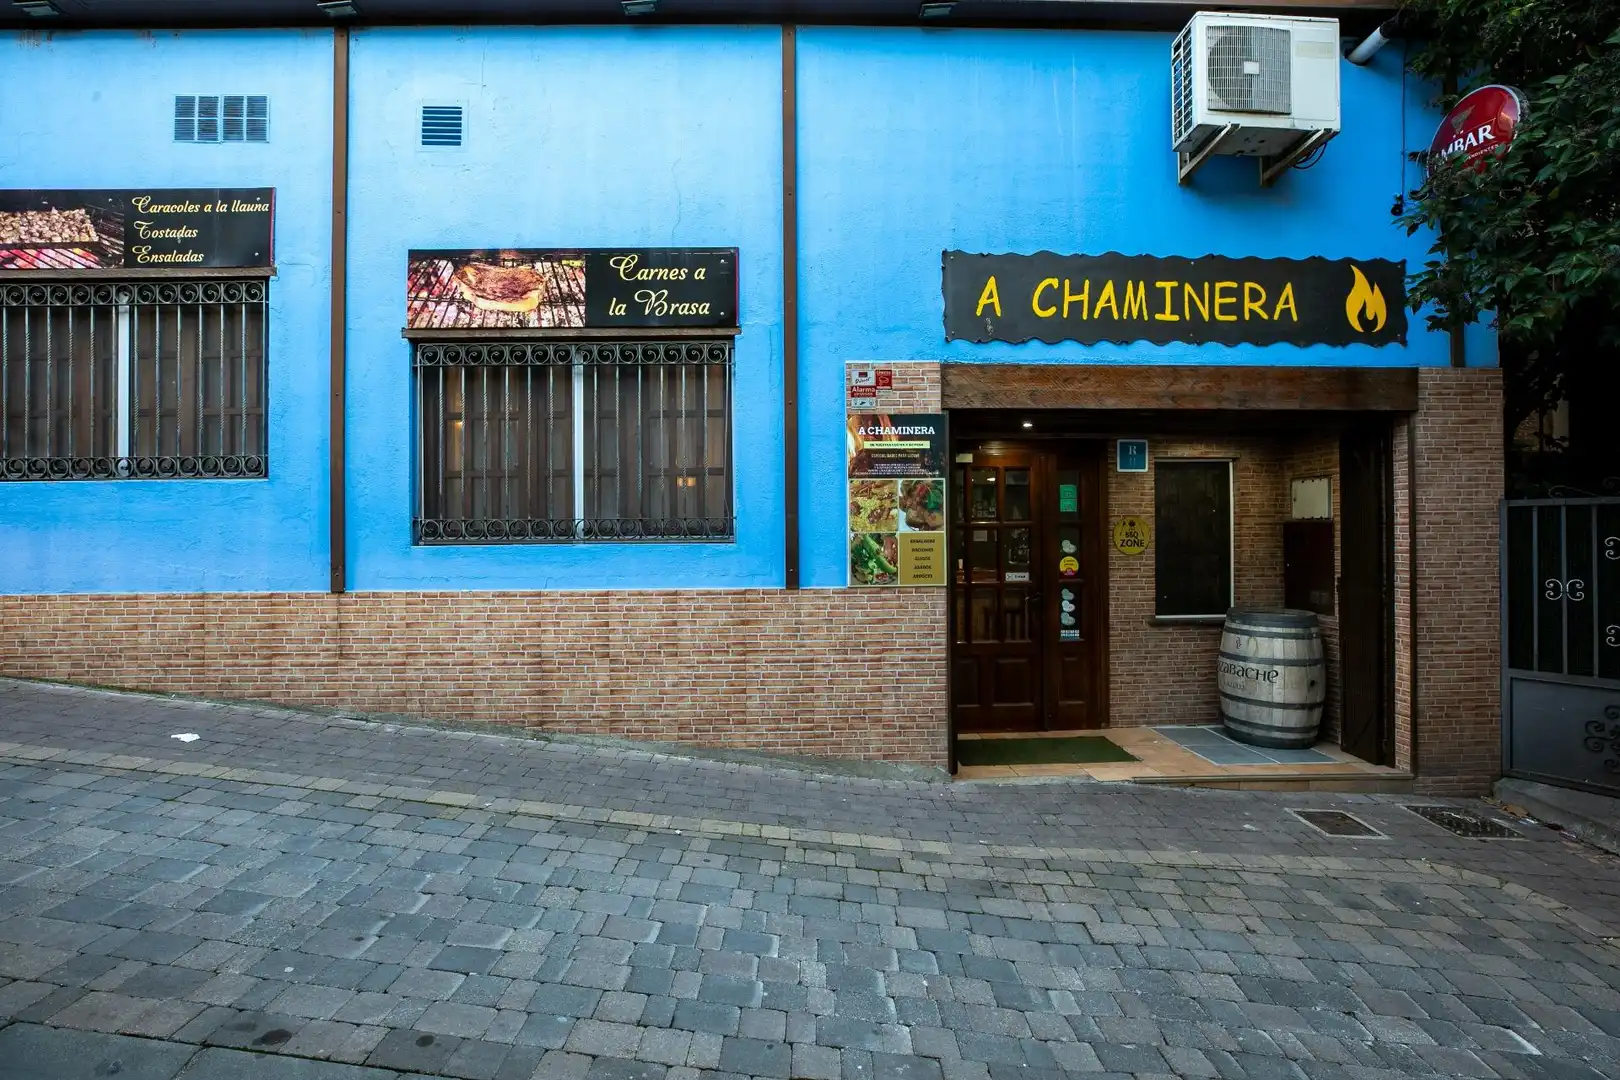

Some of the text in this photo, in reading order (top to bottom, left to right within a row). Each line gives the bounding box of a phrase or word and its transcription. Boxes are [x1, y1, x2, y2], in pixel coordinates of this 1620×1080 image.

[1440, 124, 1496, 161] MBAR
[132, 196, 269, 213] Caracoles a la llauna
[134, 220, 199, 239] Tostadas
[132, 245, 205, 263] Ensaladas
[610, 254, 706, 281] Carnes a
[608, 289, 710, 317] la Brasa
[975, 276, 1299, 322] A CHAMINERA
[851, 385, 876, 393] Alarma
[858, 426, 936, 435] A CHAMINERA
[1127, 444, 1137, 456] R
[1119, 539, 1145, 548] ZONE
